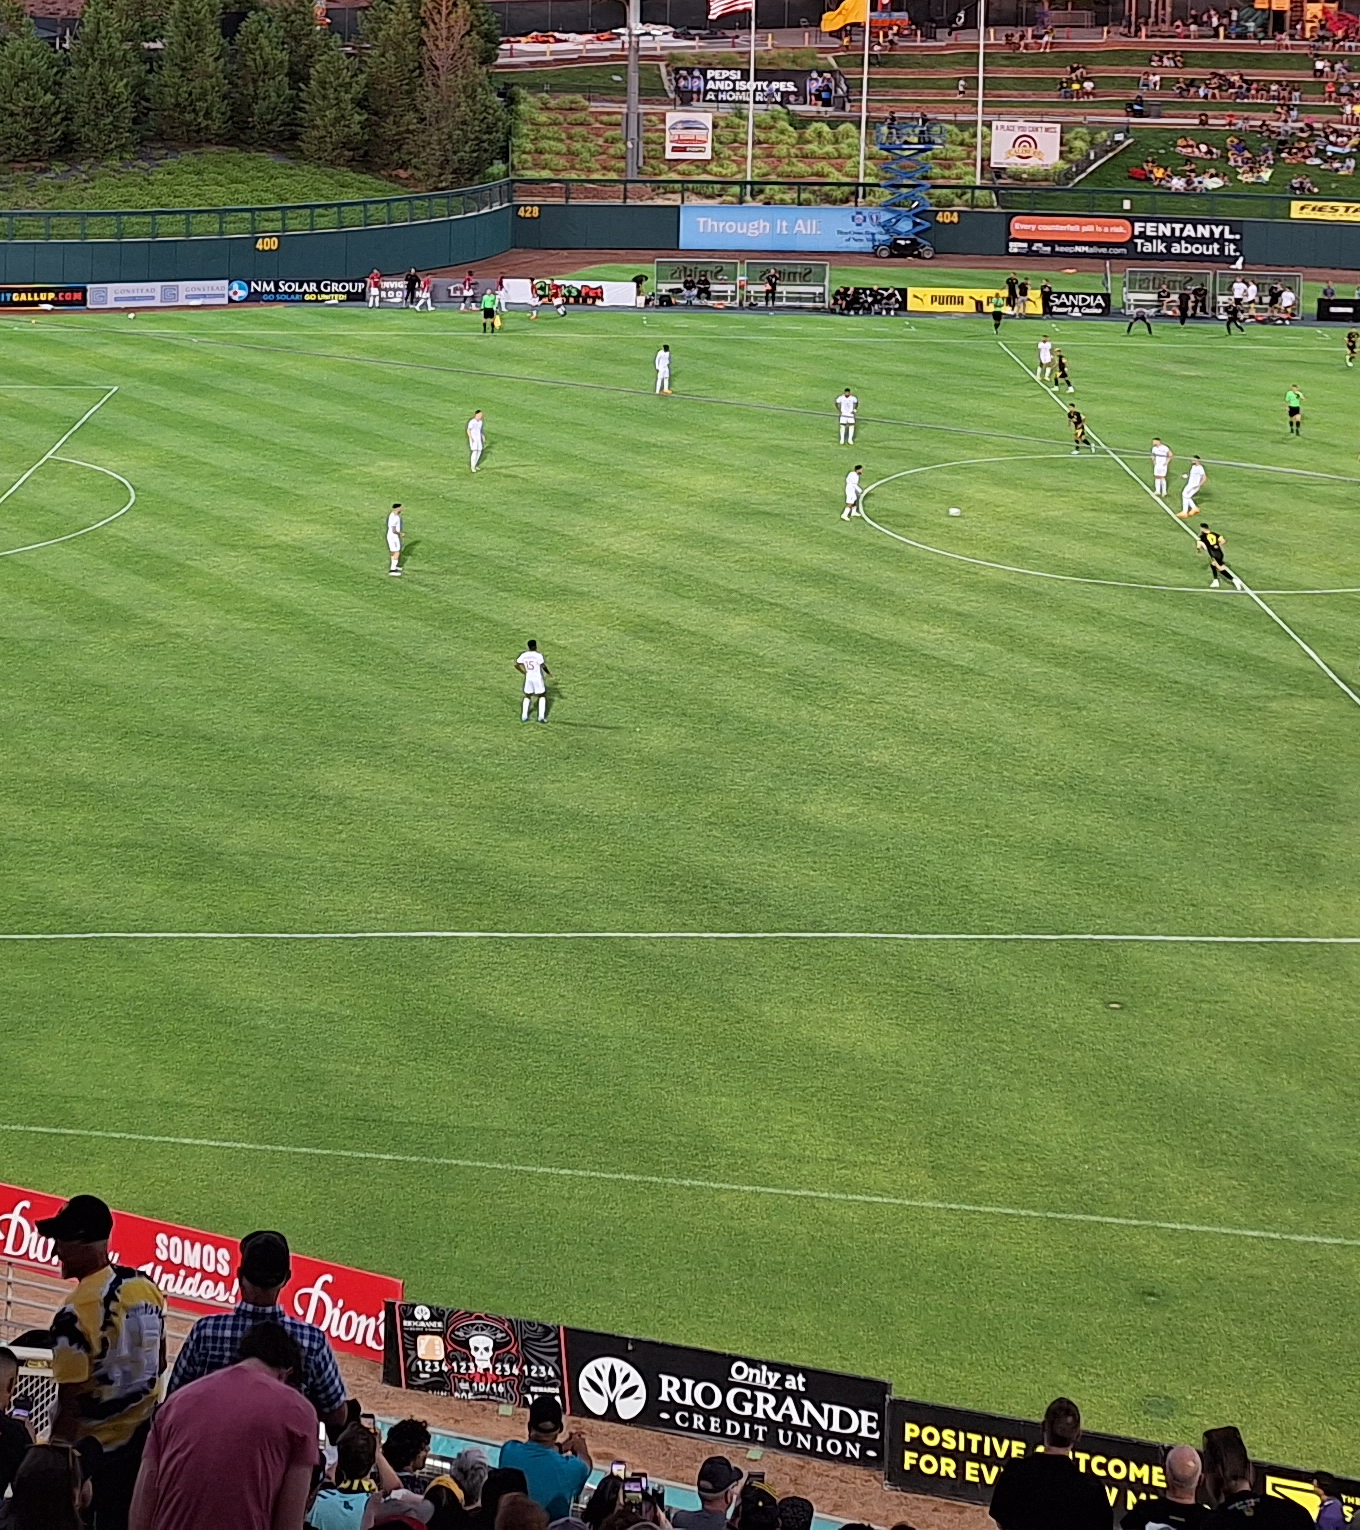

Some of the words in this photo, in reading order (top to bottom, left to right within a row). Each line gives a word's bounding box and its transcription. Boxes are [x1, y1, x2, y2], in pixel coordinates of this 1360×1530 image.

[706, 69, 741, 80] PEPSI
[706, 80, 732, 91] AND
[705, 91, 716, 101] A
[517, 205, 541, 218] 428
[935, 211, 959, 224] 404
[695, 217, 771, 238] Through
[775, 218, 789, 235] It
[793, 218, 822, 236] All.
[1133, 221, 1241, 240] FENTANYL.
[255, 236, 280, 251] 400
[1054, 244, 1128, 256] keepNMalive.com
[1134, 239, 1168, 254] Talk
[1170, 240, 1220, 256] about
[1223, 241, 1241, 257] it.
[113, 286, 157, 296] GONSTEAD
[184, 284, 227, 294] GONSTEAD
[250, 280, 276, 293] NM
[277, 280, 318, 293] SOLAR
[319, 279, 366, 294] GROUP
[581, 285, 604, 299] Pet
[262, 293, 275, 301] GO
[276, 293, 303, 301] SOLAR!
[304, 293, 317, 301] GO
[930, 294, 965, 307] PUMA
[1048, 293, 1106, 308] SANDIA
[525, 660, 536, 671] 15
[155, 1232, 232, 1277] SOMOS
[293, 1271, 387, 1352] Dion's
[416, 1360, 449, 1373] 1234
[521, 1365, 556, 1378] 1234
[730, 1360, 783, 1391] Only
[783, 1371, 807, 1393] at
[674, 1410, 768, 1444] CREDIT
[776, 1427, 864, 1460] UNION
[903, 1421, 1028, 1460] POSITIVE
[903, 1449, 957, 1479] FOR
